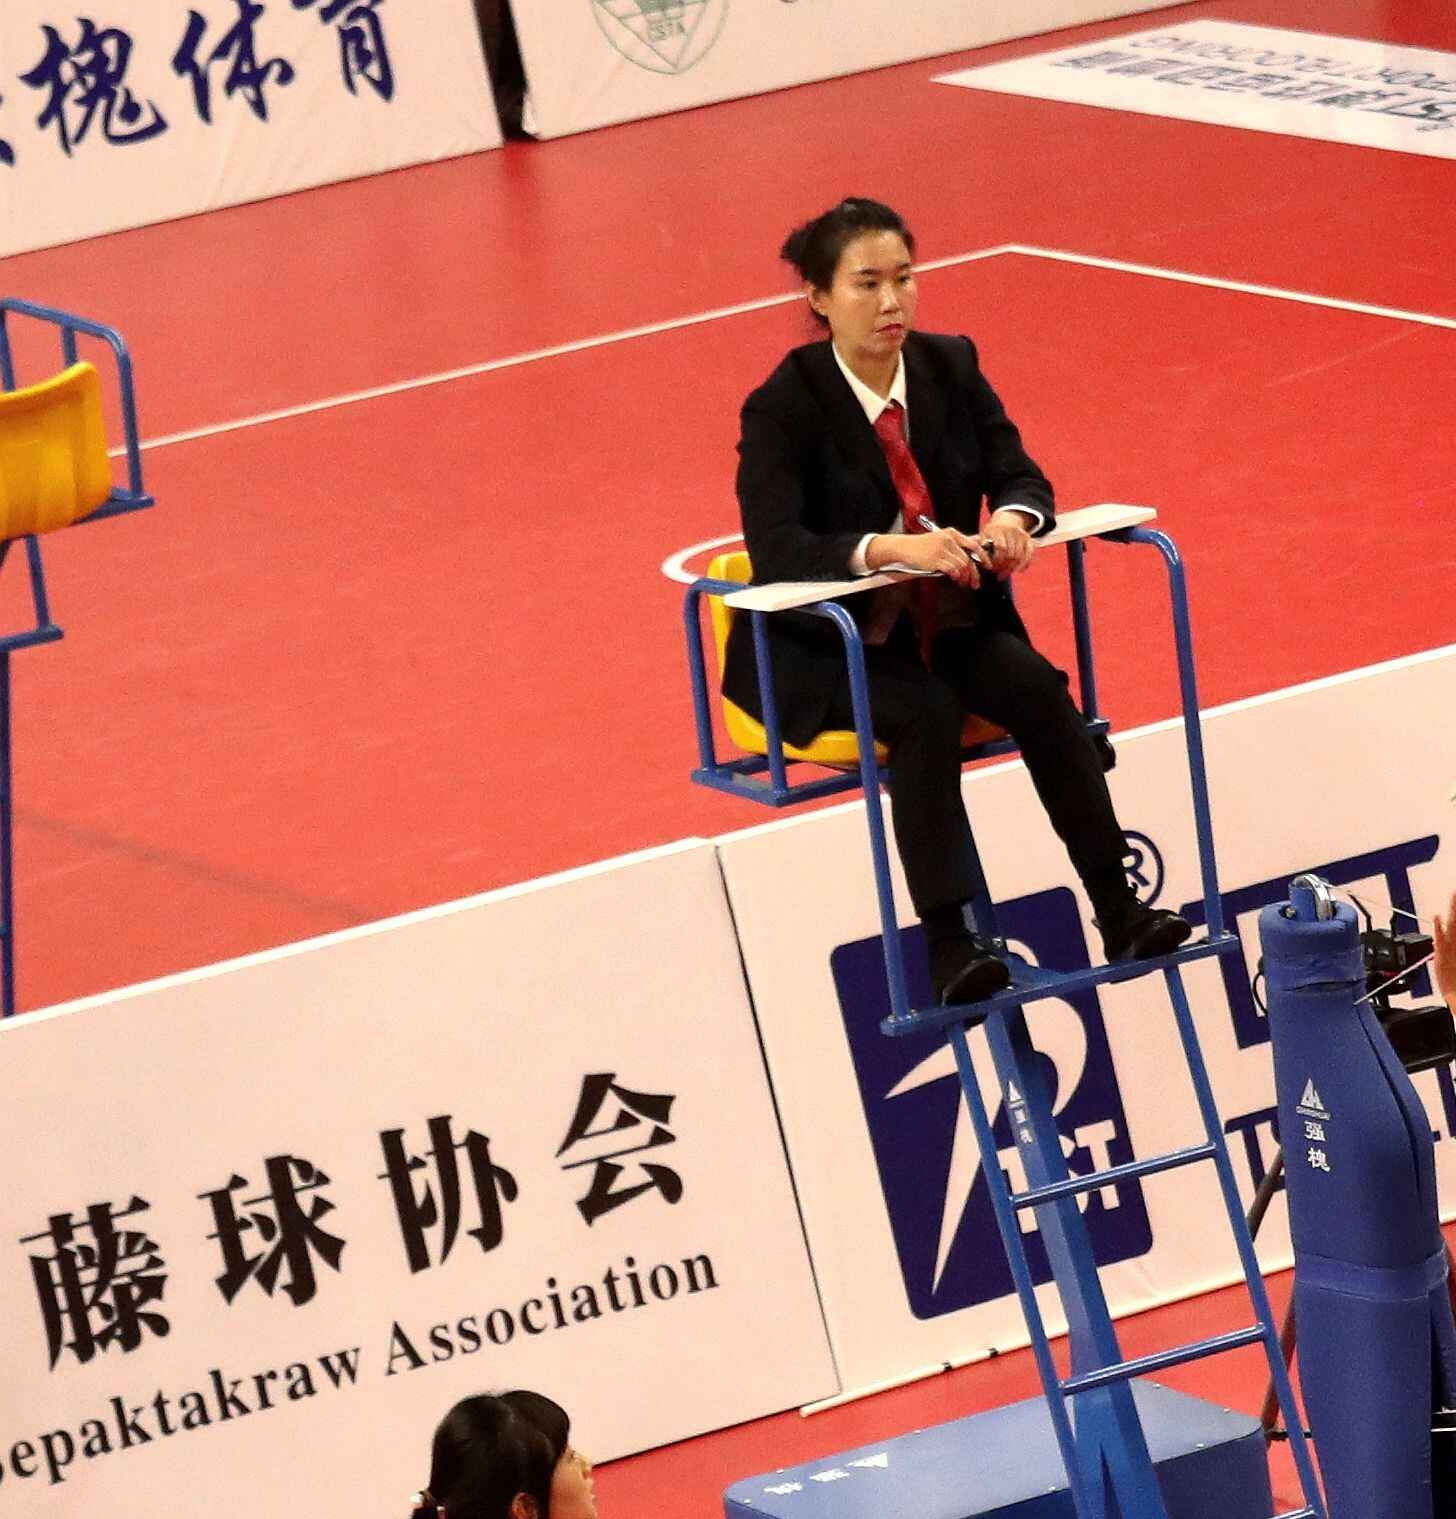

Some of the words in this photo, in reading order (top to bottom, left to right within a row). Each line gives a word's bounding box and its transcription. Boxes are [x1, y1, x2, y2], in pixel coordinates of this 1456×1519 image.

[0, 0, 394, 166] 槐体育
[20, 1072, 684, 1370] 藤球协会
[0, 1346, 362, 1486] epaktakraw
[383, 1251, 720, 1376] Association
